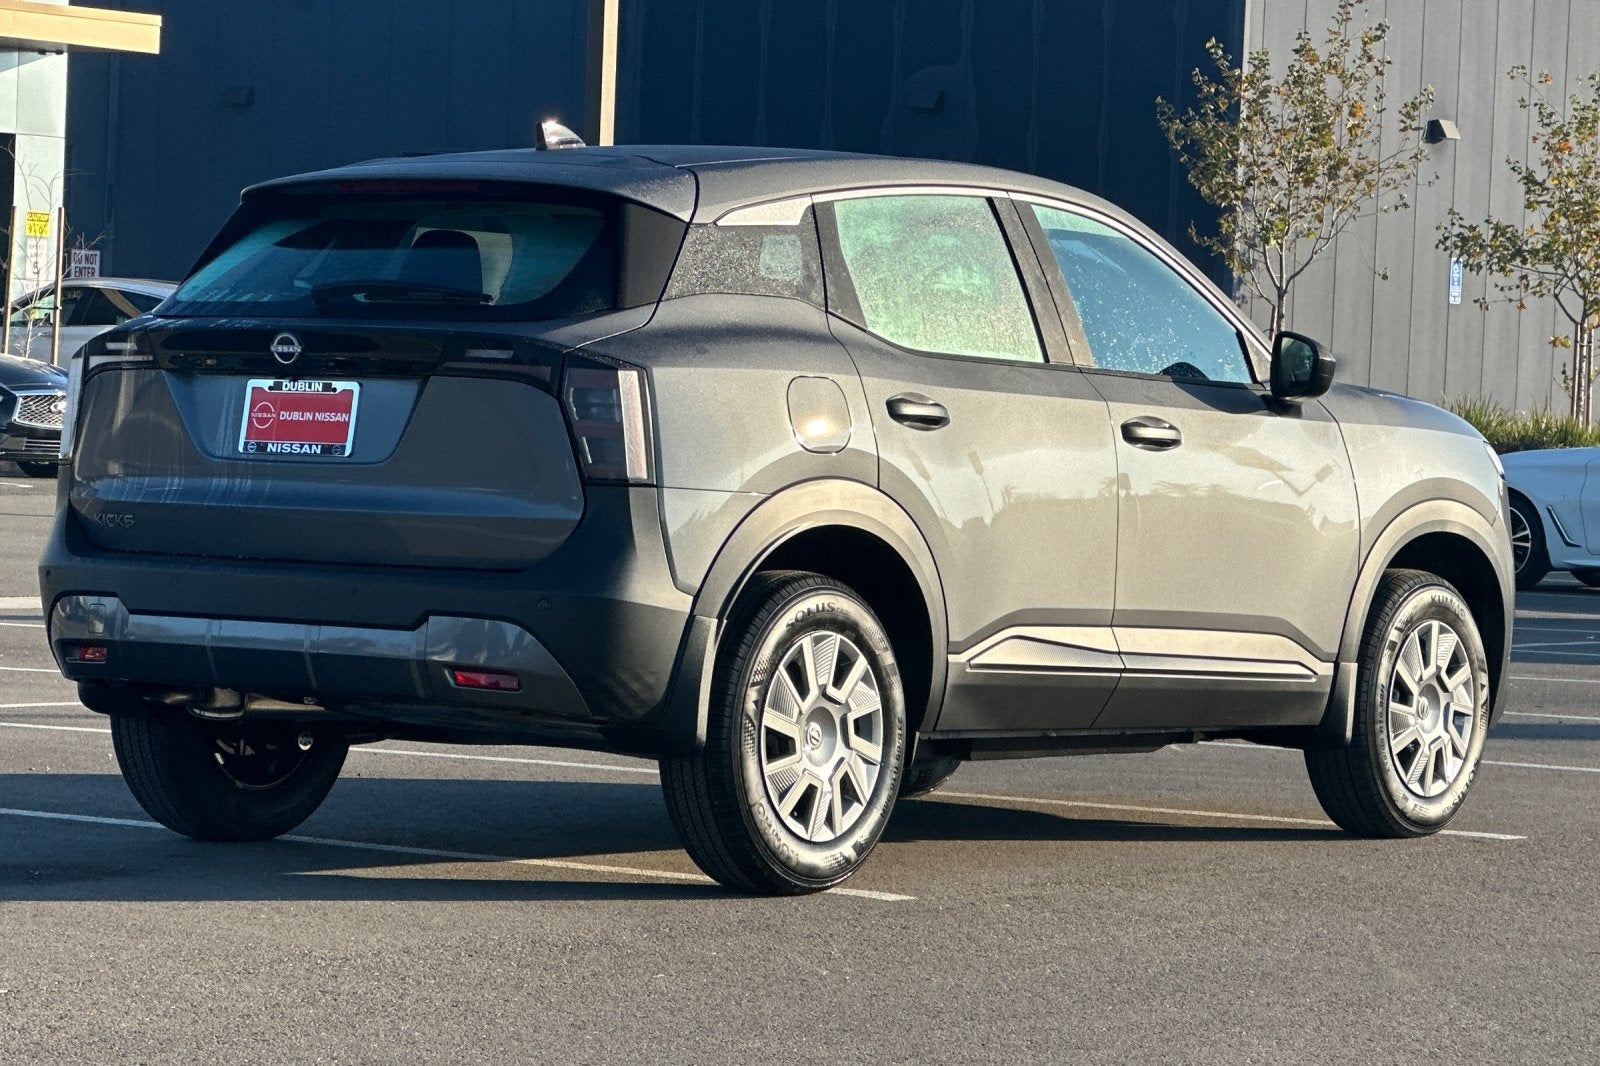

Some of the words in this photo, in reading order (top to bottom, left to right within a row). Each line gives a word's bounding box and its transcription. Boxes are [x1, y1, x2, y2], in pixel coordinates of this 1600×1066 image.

[73, 251, 82, 265] DO
[84, 252, 98, 265] NOT
[74, 266, 96, 278] ENTER
[271, 344, 301, 353] NISSAN
[282, 381, 323, 392] DUBLIN
[251, 411, 276, 419] NISSAN
[279, 411, 314, 421] DUBLIN
[315, 412, 350, 422] NISSAN
[267, 443, 321, 454] NISSAN
[94, 513, 135, 528] KICKS
[785, 602, 836, 629] SOLUS
